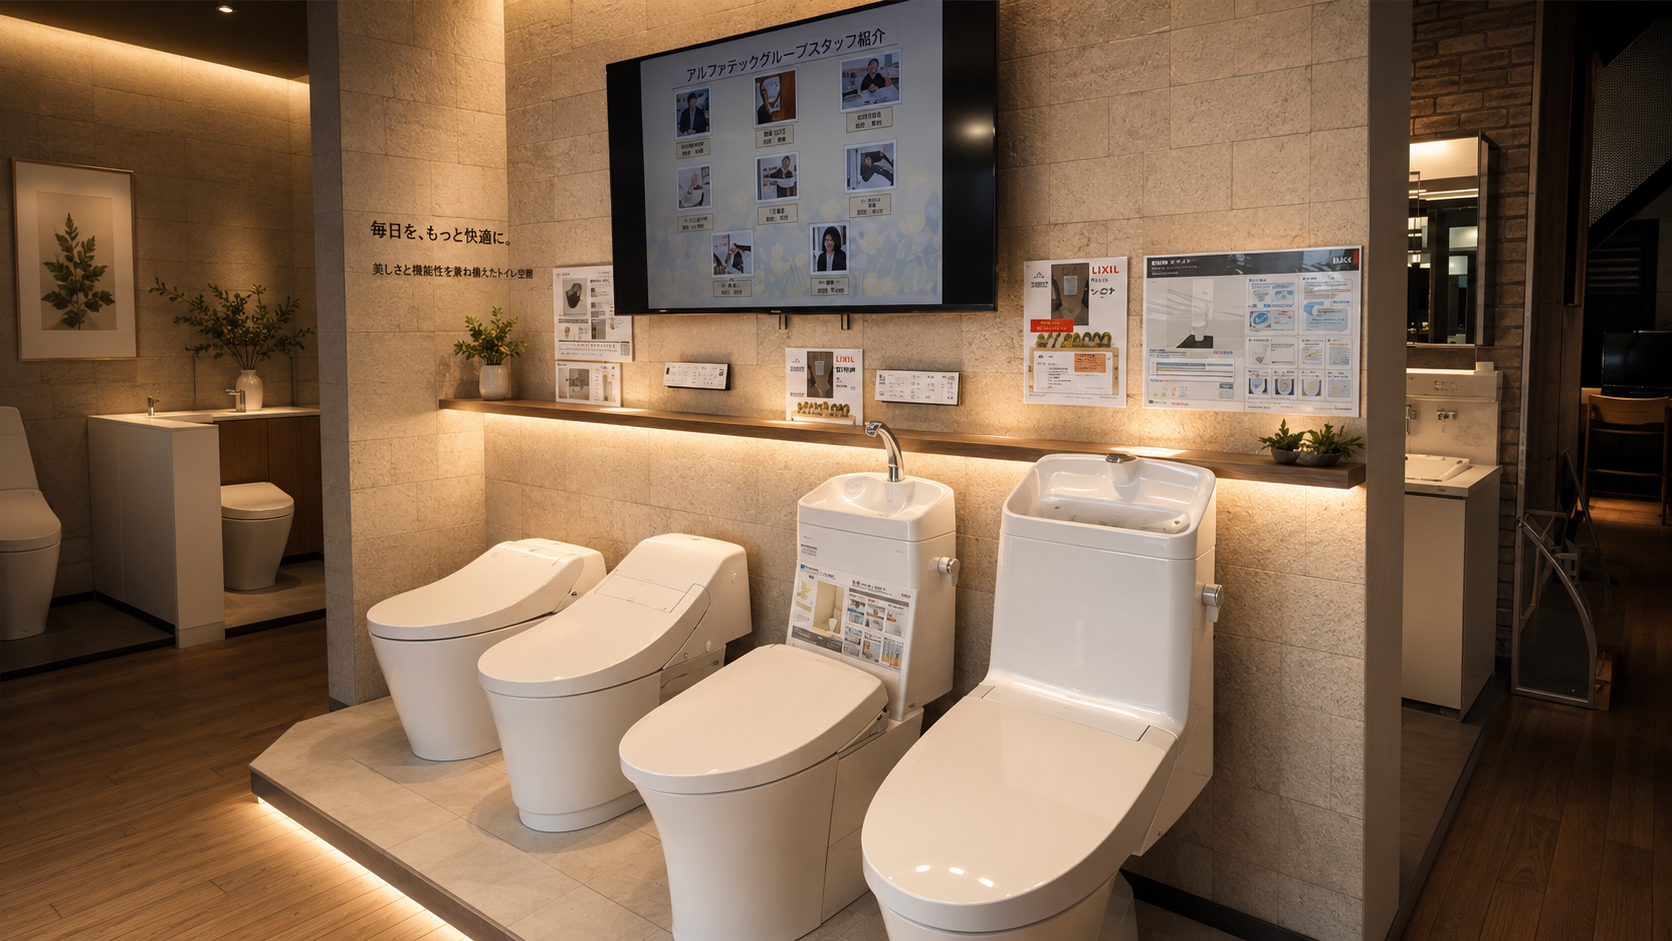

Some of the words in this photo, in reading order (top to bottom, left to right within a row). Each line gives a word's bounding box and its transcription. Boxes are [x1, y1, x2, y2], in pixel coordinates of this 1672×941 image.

[370, 219, 511, 246] 毎日を、もっと快適に。
[1091, 265, 1120, 275] LIXIL
